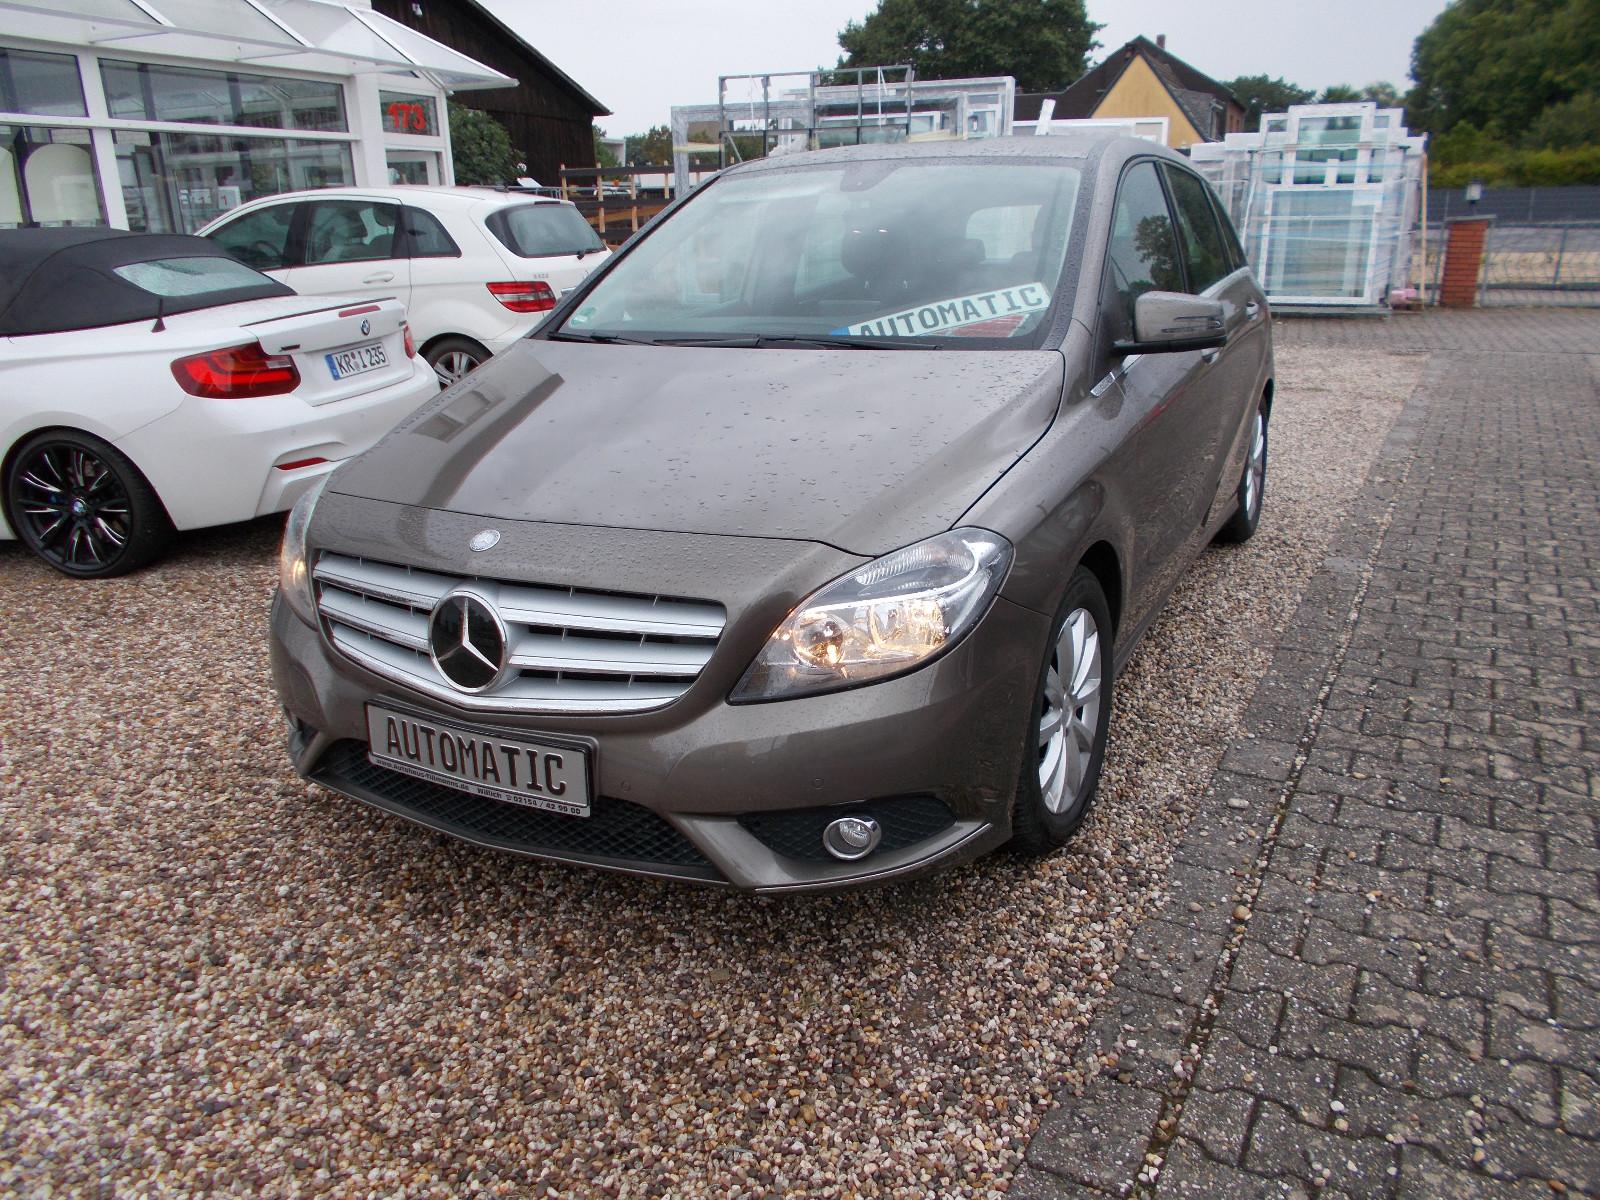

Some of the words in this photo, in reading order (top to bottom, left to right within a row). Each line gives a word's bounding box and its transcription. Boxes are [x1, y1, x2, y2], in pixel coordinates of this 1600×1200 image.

[387, 102, 426, 129] 173
[860, 286, 1042, 336] AUTOMATIC
[336, 352, 356, 375] KR
[366, 346, 386, 367] 235
[387, 715, 567, 796] AUTOMATIC
